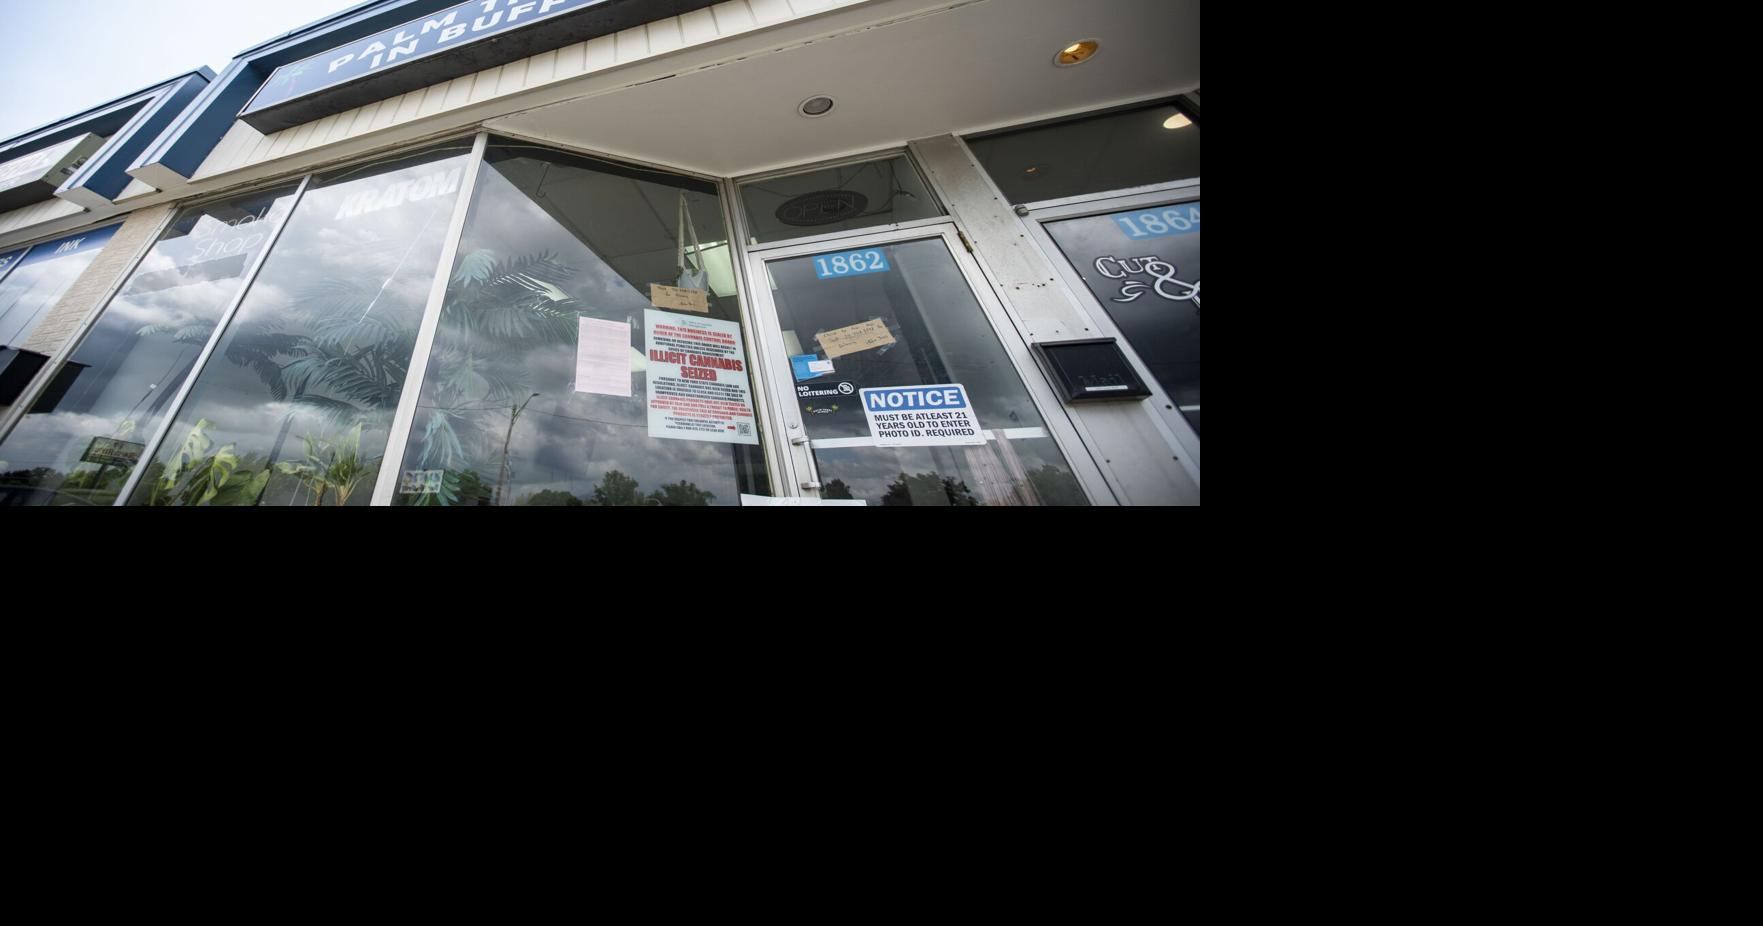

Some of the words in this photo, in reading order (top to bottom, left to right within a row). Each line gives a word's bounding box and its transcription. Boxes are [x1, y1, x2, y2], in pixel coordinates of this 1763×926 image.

[328, 11, 458, 74] PALM
[370, 38, 419, 70] IN
[334, 167, 460, 220] KRATOM
[54, 237, 86, 255] INK
[193, 232, 263, 260] Shop
[817, 251, 884, 277] 1862
[649, 349, 687, 365] ILLICIT
[689, 353, 743, 372] CANNABIS
[680, 366, 718, 381] SEIZED
[798, 389, 839, 397] LOITERING
[870, 389, 961, 408] NOTICE
[874, 413, 900, 421] MUST
[901, 413, 914, 421] BE
[915, 412, 953, 420] ATLEAST
[955, 411, 968, 419] 21
[876, 421, 905, 430] YEARS
[907, 421, 925, 429] OLD
[926, 421, 939, 429] TO
[942, 420, 971, 428] ENTER
[879, 430, 908, 438] PHOTO
[911, 429, 924, 437] ID.
[926, 428, 975, 437] REQUIRED
